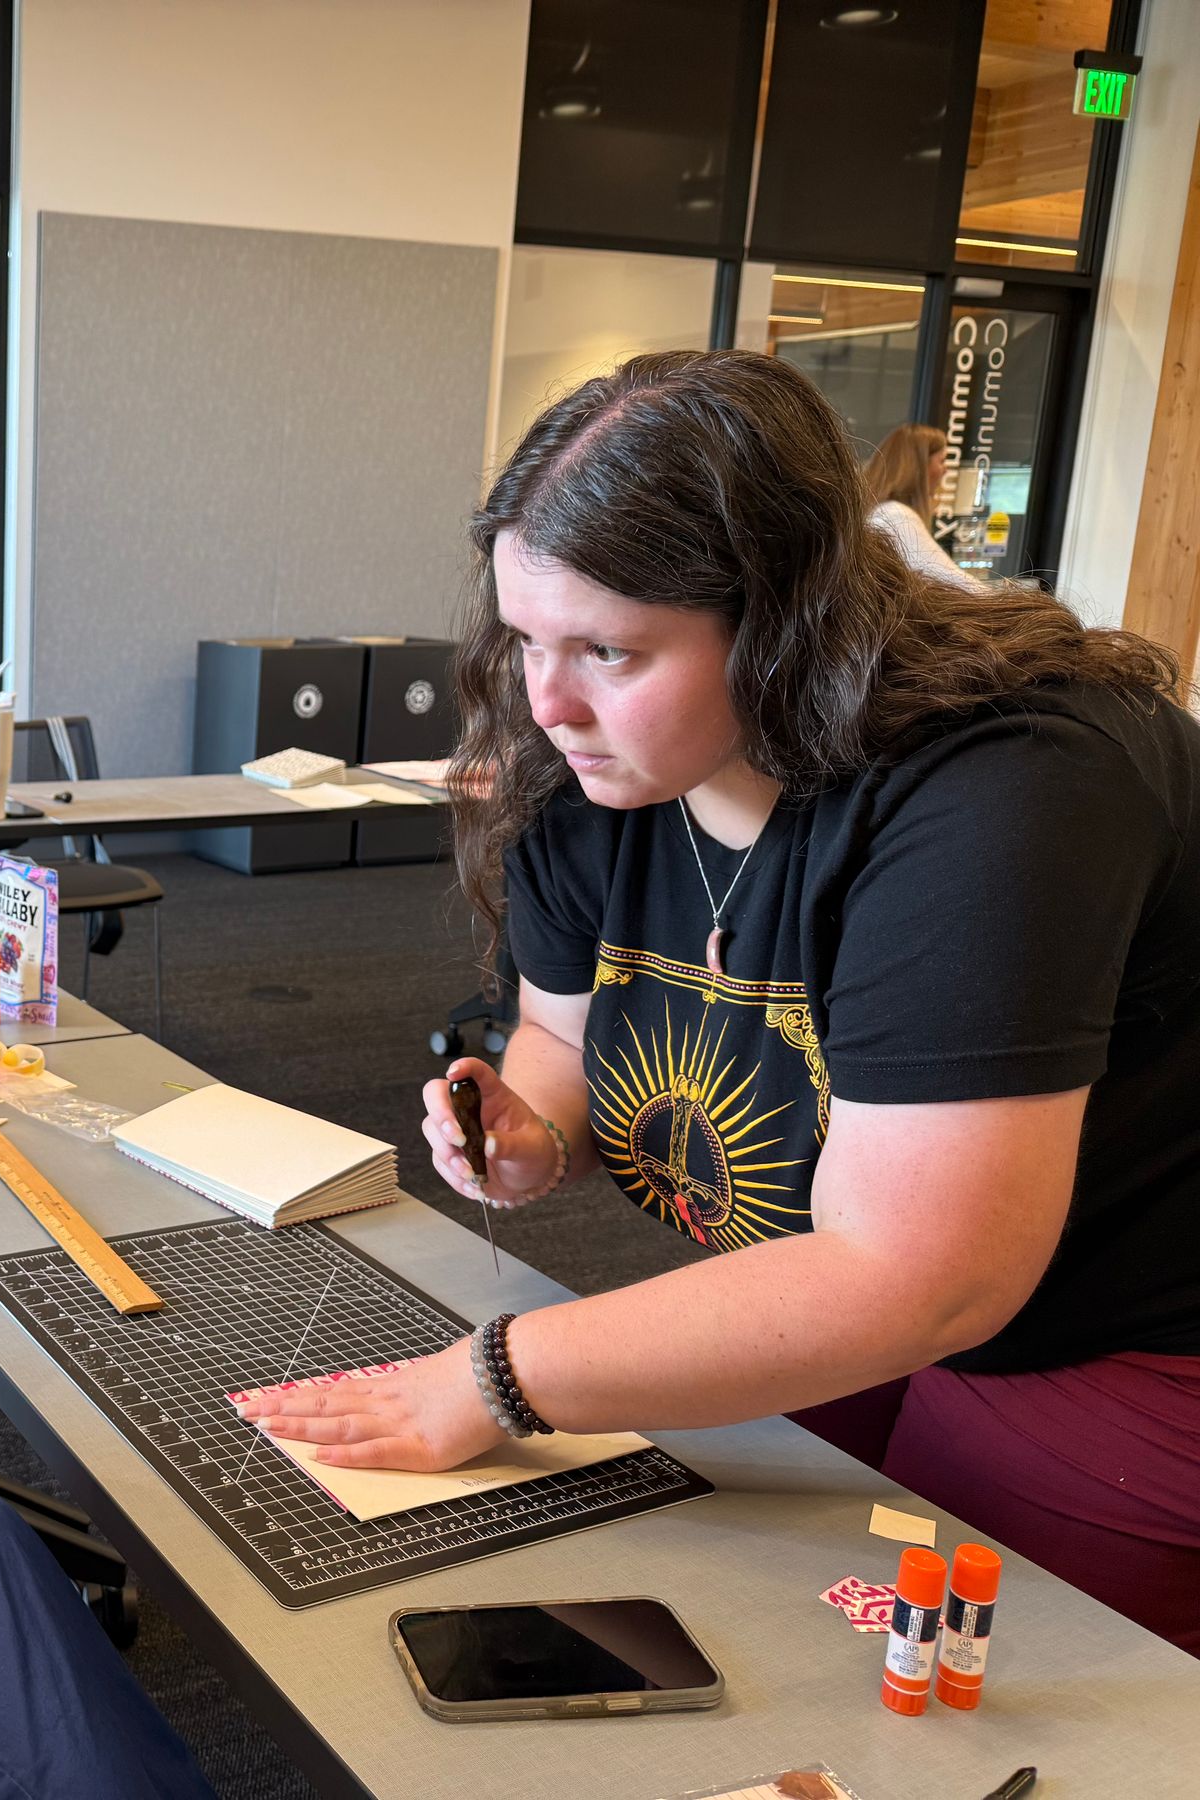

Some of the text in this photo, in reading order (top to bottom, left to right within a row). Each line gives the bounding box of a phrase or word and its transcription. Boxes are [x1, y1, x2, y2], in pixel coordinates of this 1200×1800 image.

[1084, 70, 1127, 116] EXIT
[199, 1454, 211, 1463] 12
[220, 1475, 234, 1484] 13
[242, 1497, 255, 1507] 14
[266, 1521, 279, 1531] 15
[289, 1545, 304, 1556] 16
